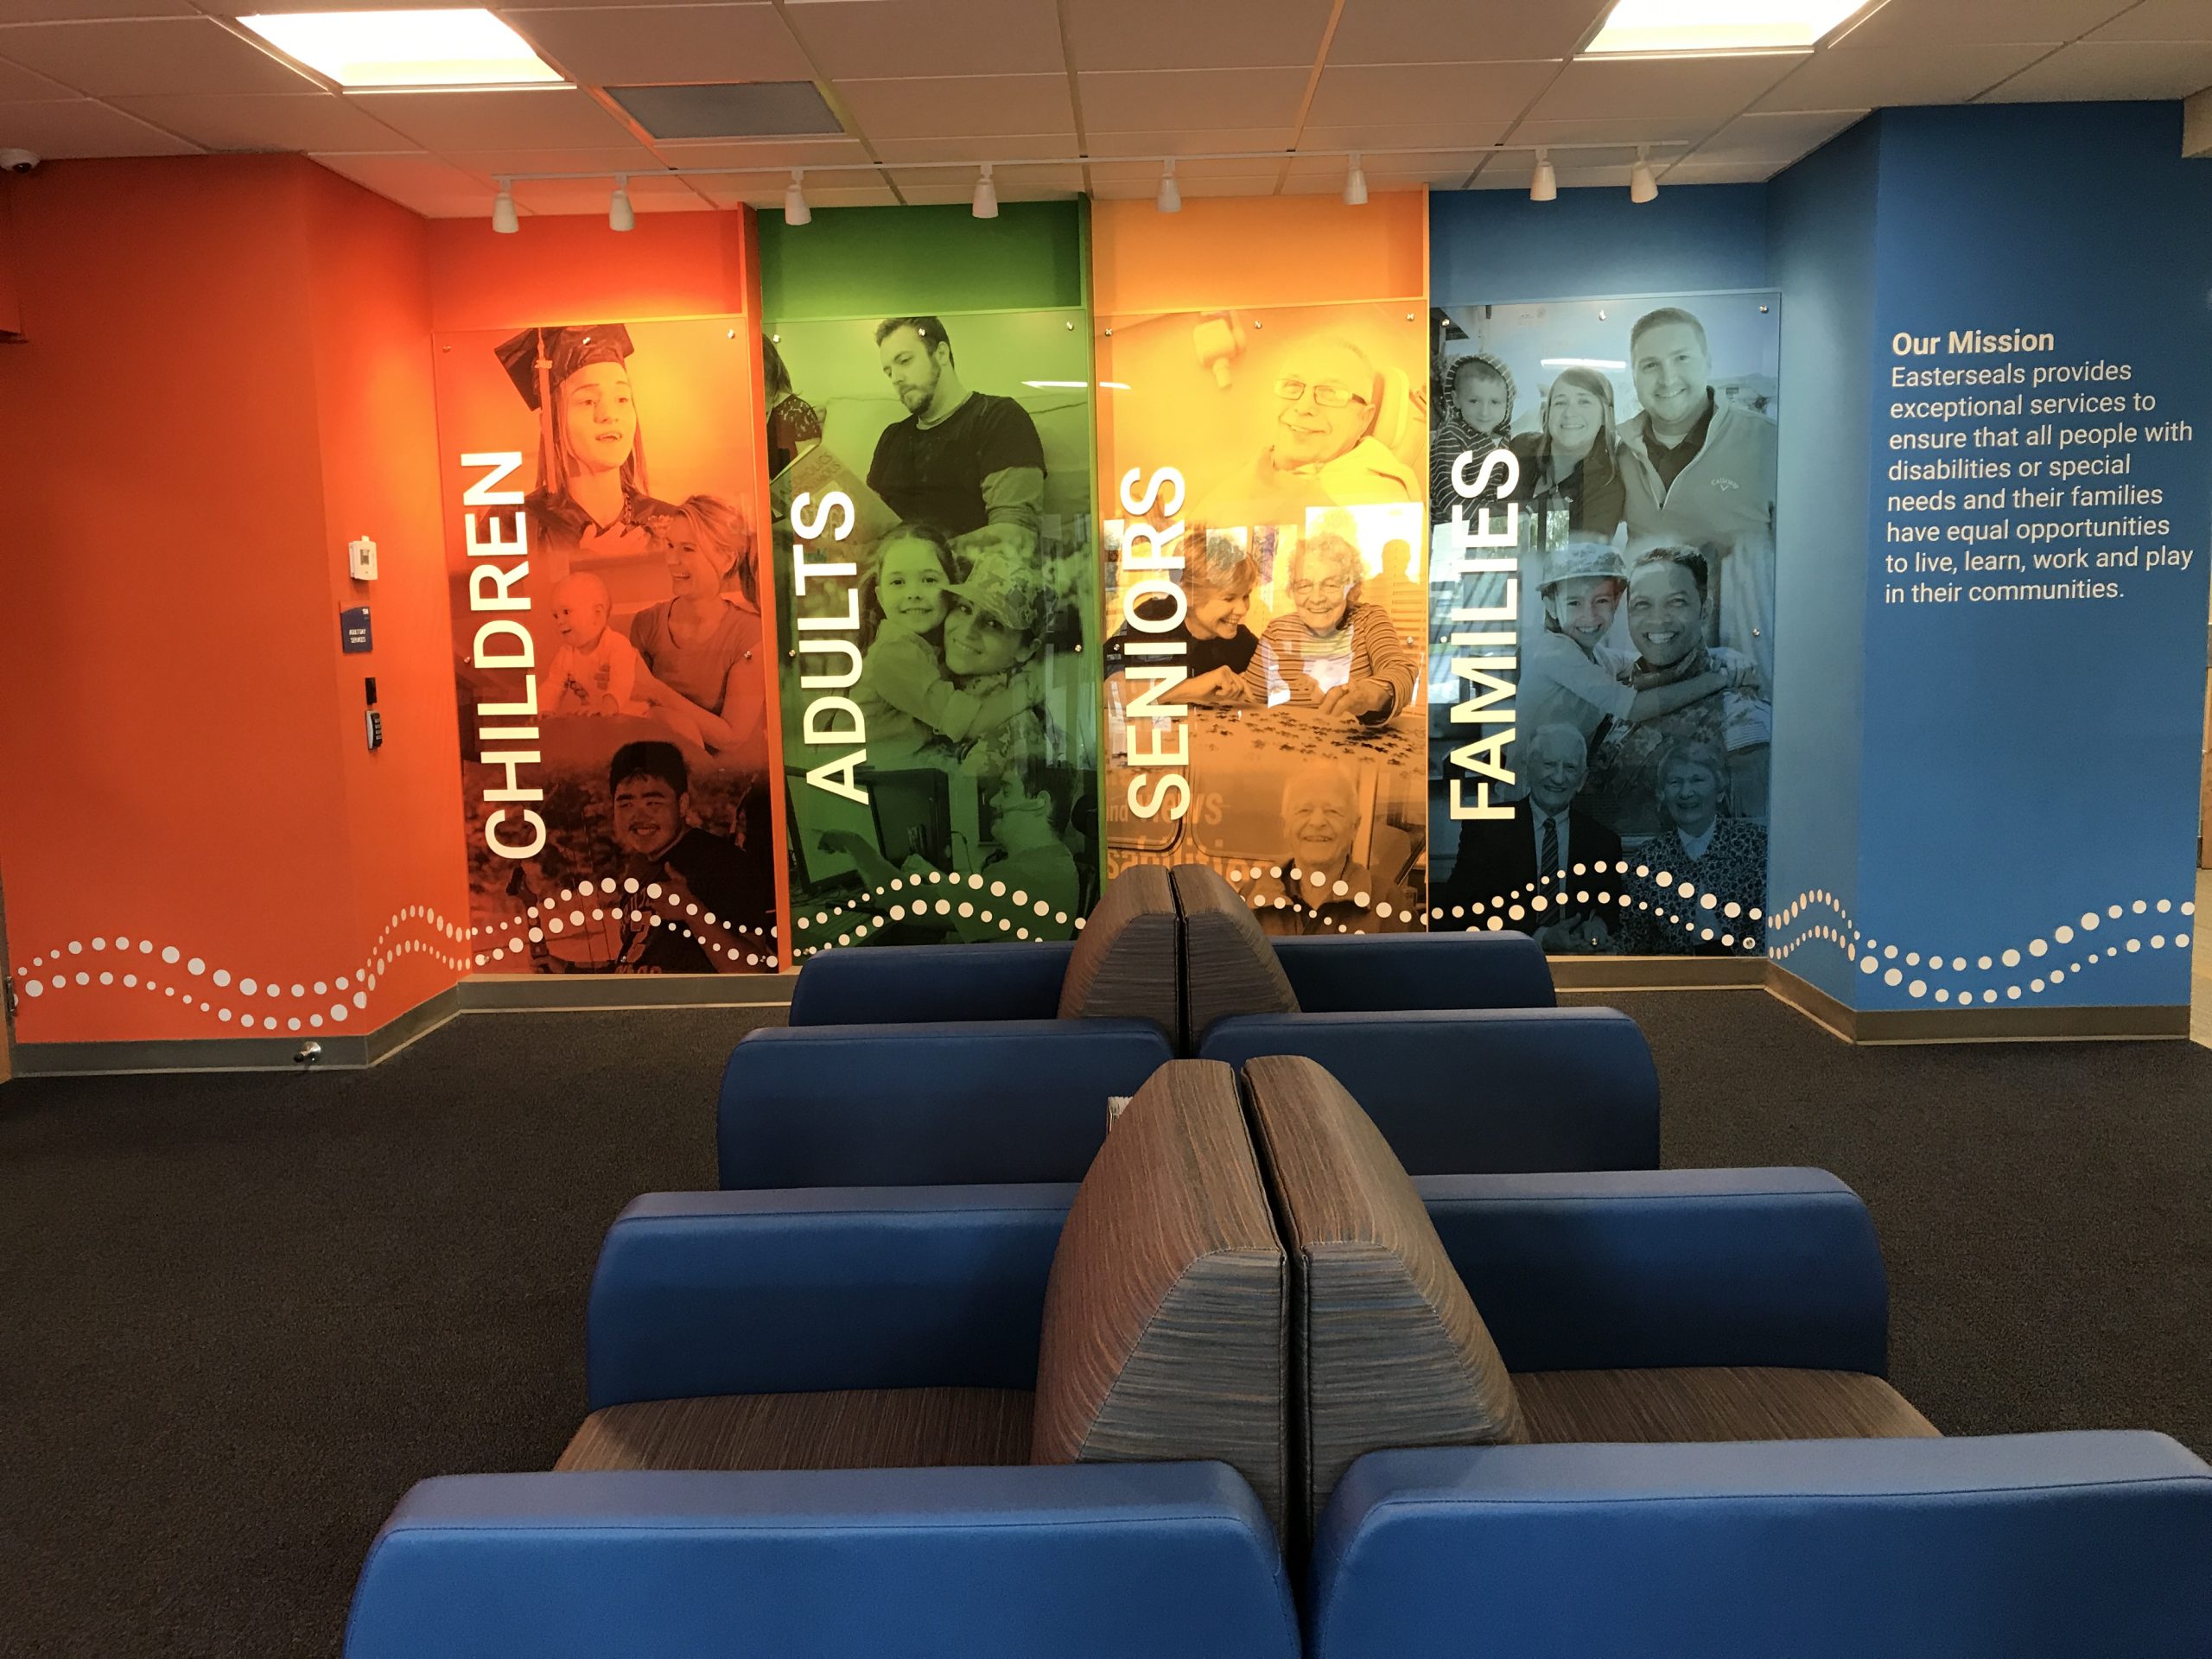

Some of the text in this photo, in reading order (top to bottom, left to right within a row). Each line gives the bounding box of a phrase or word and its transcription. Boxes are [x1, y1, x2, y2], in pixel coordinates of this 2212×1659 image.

[1892, 327, 2055, 357] Our Mission
[1891, 359, 2132, 388] Easterseals provides
[1890, 392, 2156, 423] exceptional services to
[1889, 420, 2192, 450] ensure that all people with
[1888, 453, 2131, 481] disabilities or special
[1887, 484, 2163, 512] needs and their families
[1887, 516, 2170, 545] have equal opportunities
[1885, 544, 2194, 575] to live, learn, work and play
[1885, 578, 2124, 604] in their communities.
[791, 492, 869, 805] ADULTS
[1120, 467, 1191, 821] SENIORS
[1450, 448, 1520, 821] FAMILIES
[461, 451, 546, 860] CHILDREN
